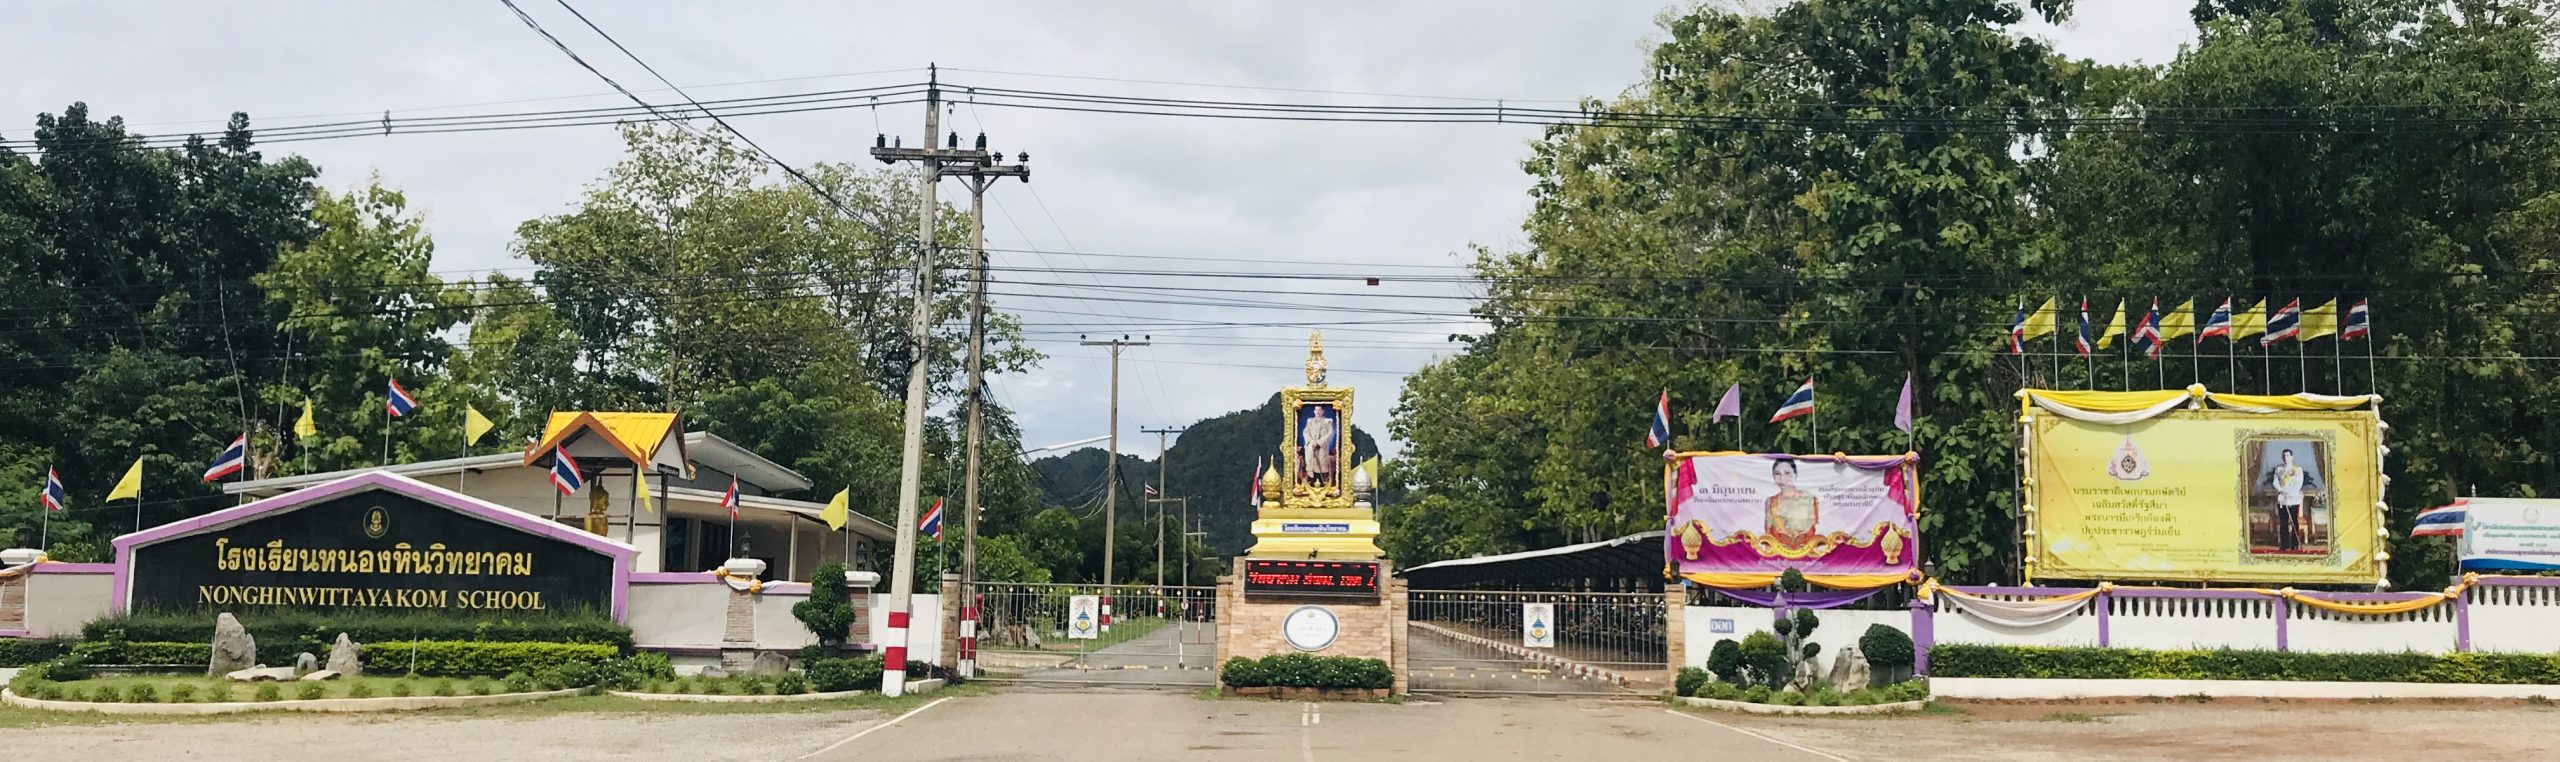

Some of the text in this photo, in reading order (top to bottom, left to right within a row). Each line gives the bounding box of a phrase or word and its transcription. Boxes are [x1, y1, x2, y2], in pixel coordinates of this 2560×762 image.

[1712, 484, 1756, 496] มิถุนายน
[216, 538, 533, 576] โรงเรียนหนองหินวิทยาคม
[198, 585, 546, 611] NONGHINWITTAYAKOM SCHOOL
